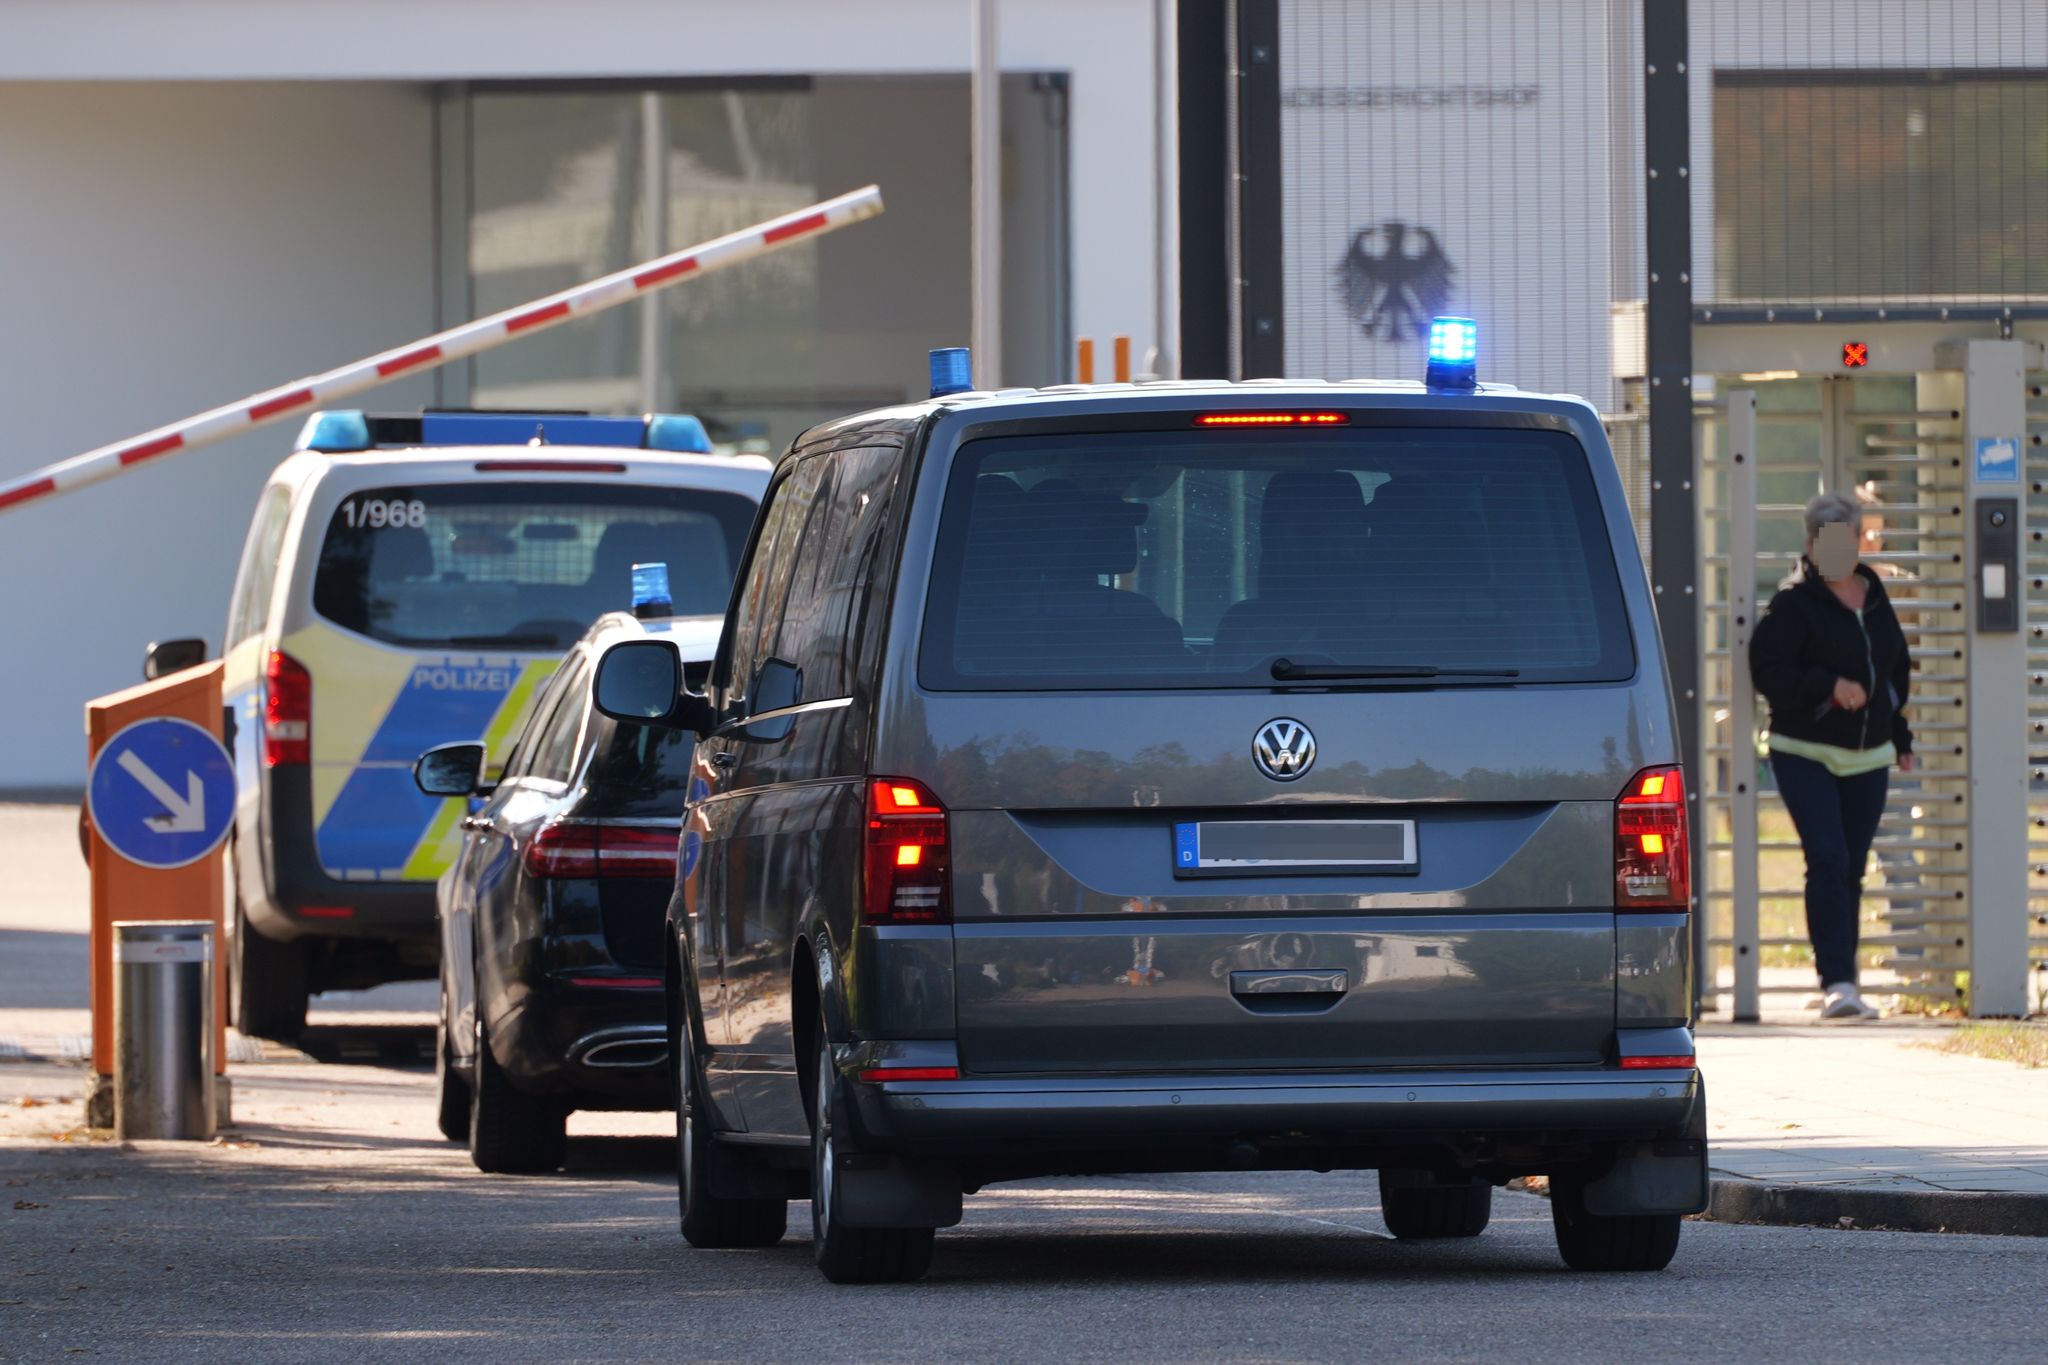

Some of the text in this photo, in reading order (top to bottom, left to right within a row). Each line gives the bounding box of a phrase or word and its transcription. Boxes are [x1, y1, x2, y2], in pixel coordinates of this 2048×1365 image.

[342, 499, 426, 528] 1/968
[413, 667, 511, 691] POLIZEI
[1183, 851, 1193, 862] D
